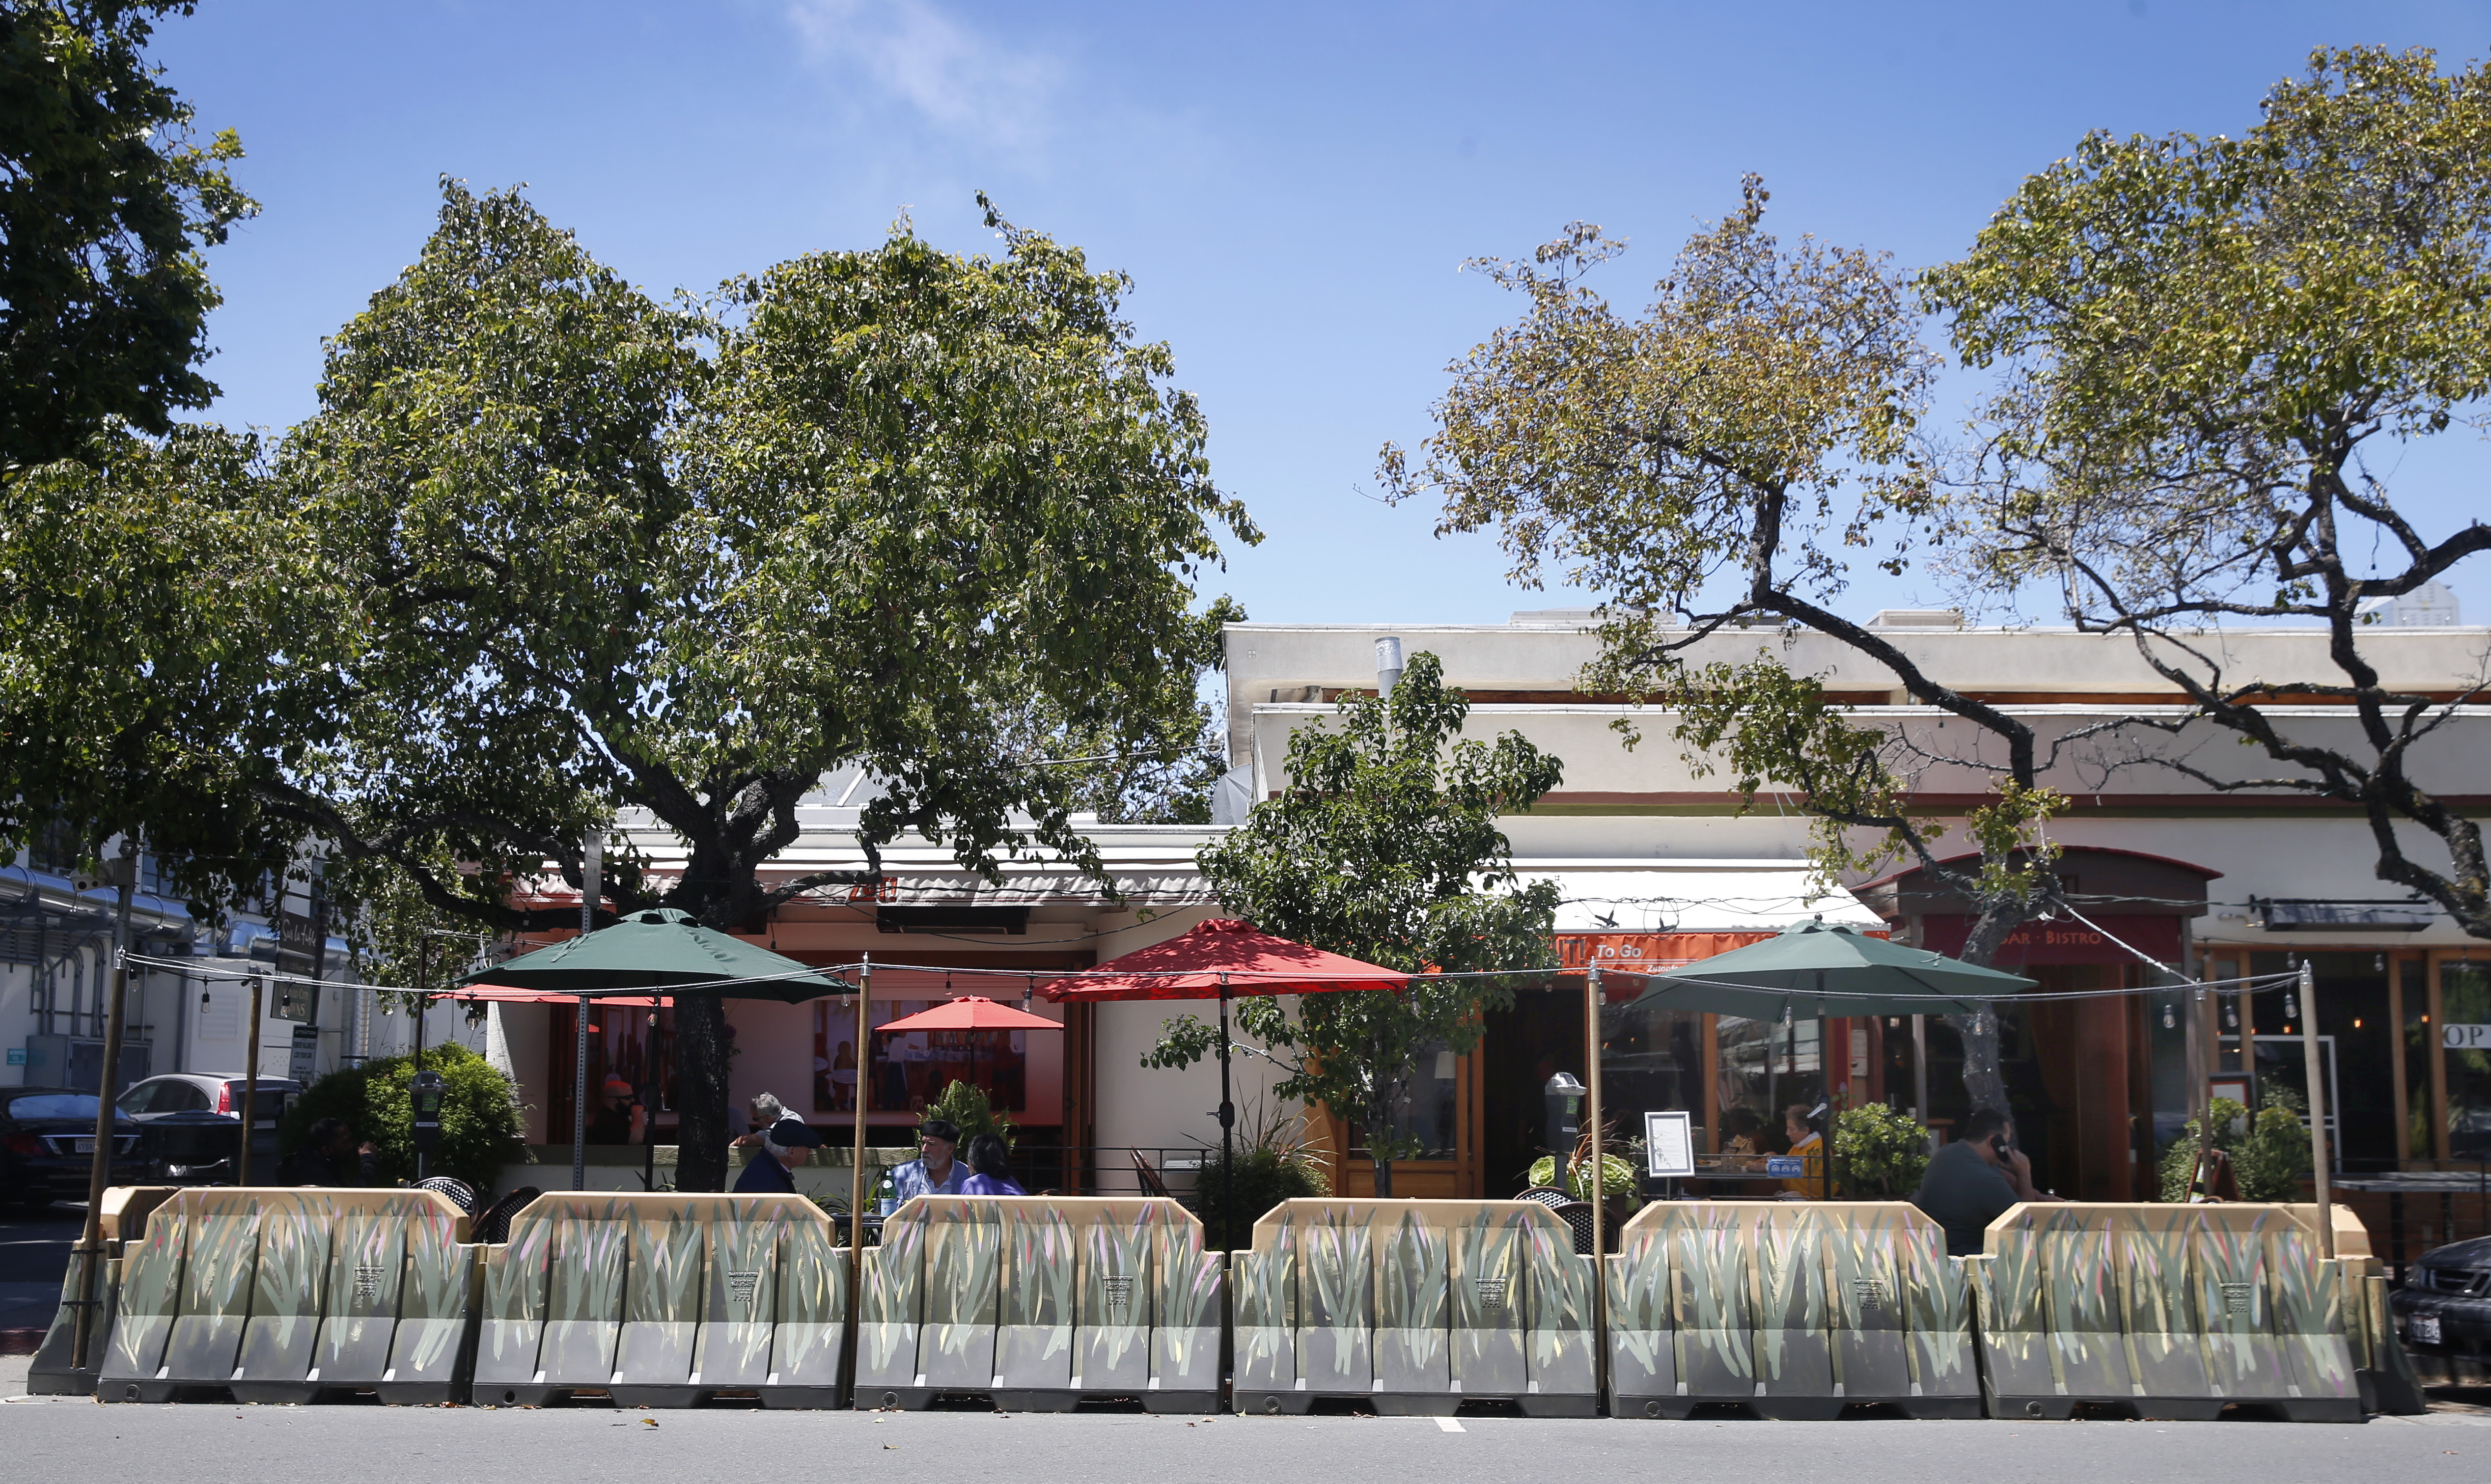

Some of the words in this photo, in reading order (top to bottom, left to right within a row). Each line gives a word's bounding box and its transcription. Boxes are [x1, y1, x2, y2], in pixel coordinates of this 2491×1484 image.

[294, 924, 301, 942] la
[301, 924, 316, 947] table
[2046, 931, 2102, 944] BISTRO
[1552, 939, 1585, 965] UT!
[1596, 944, 1615, 958] To
[1620, 944, 1642, 958] Go
